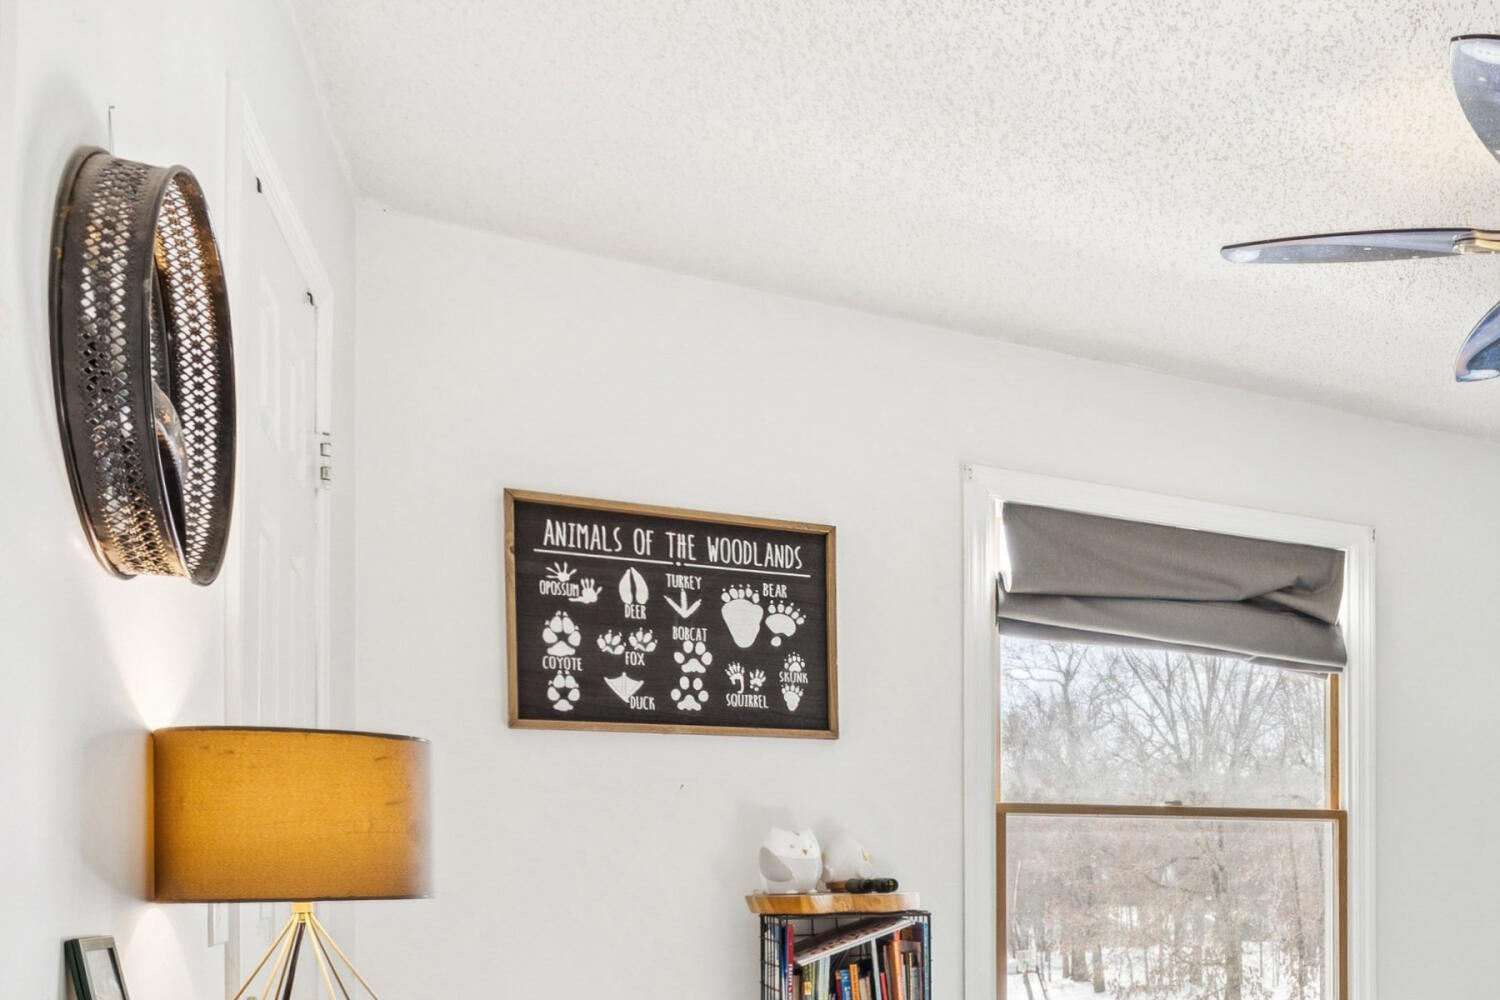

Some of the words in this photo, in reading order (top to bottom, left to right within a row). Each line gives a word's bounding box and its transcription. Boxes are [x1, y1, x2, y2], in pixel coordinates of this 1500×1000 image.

[543, 519, 622, 552] ANIMALS
[633, 528, 654, 556] OF
[665, 531, 697, 561] THE
[707, 536, 803, 570] WOODLANDS
[540, 580, 580, 598] OPOSSUM
[665, 573, 702, 590] TURKEY
[762, 583, 788, 599] BEAR
[624, 604, 647, 620] DEER
[672, 626, 708, 642] BOBCAT
[542, 655, 583, 672] COYOTE
[625, 651, 646, 666] FOX
[779, 671, 808, 684] SKUNK
[630, 696, 656, 711] DUCK
[725, 693, 769, 709] SQUIRREL
